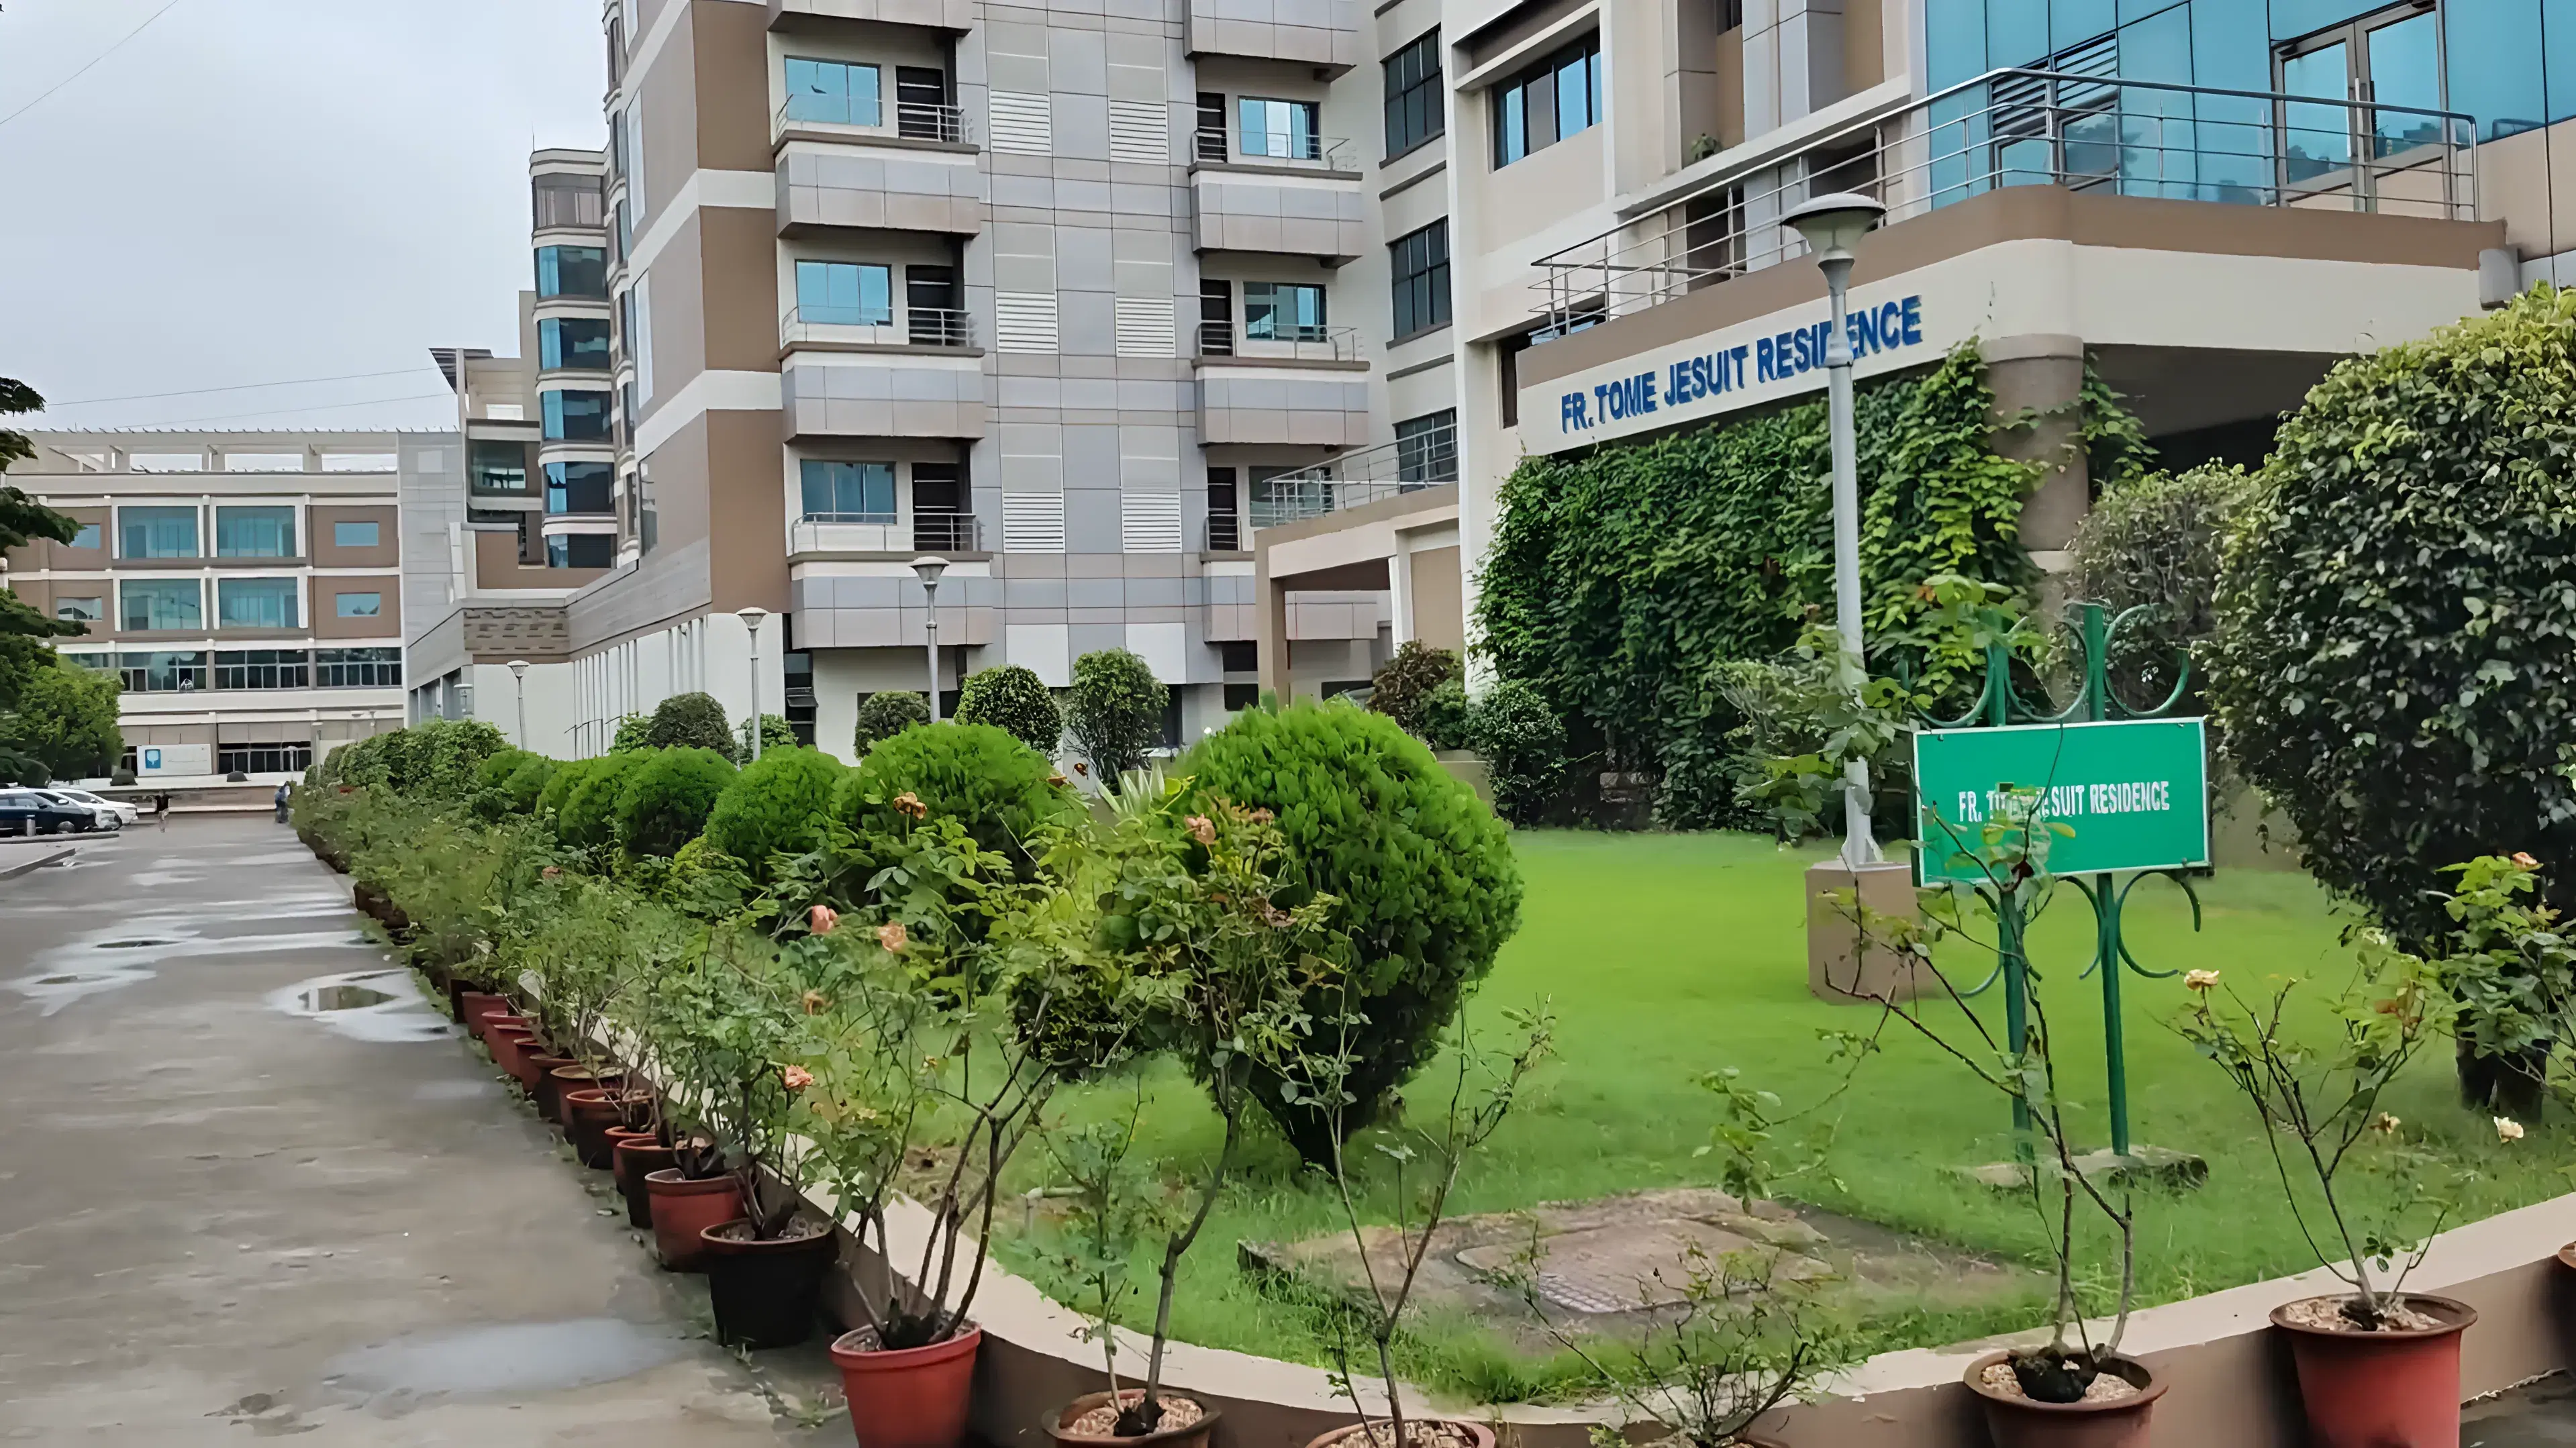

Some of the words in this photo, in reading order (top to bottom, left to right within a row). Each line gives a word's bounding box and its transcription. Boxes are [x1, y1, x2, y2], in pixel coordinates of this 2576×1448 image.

[1561, 392, 1595, 434] FR.
[1595, 370, 1658, 424] TOME
[1664, 345, 1749, 407] JESUIT
[1959, 790, 1983, 823] FR.
[2089, 780, 2170, 814] RESIDENCE
